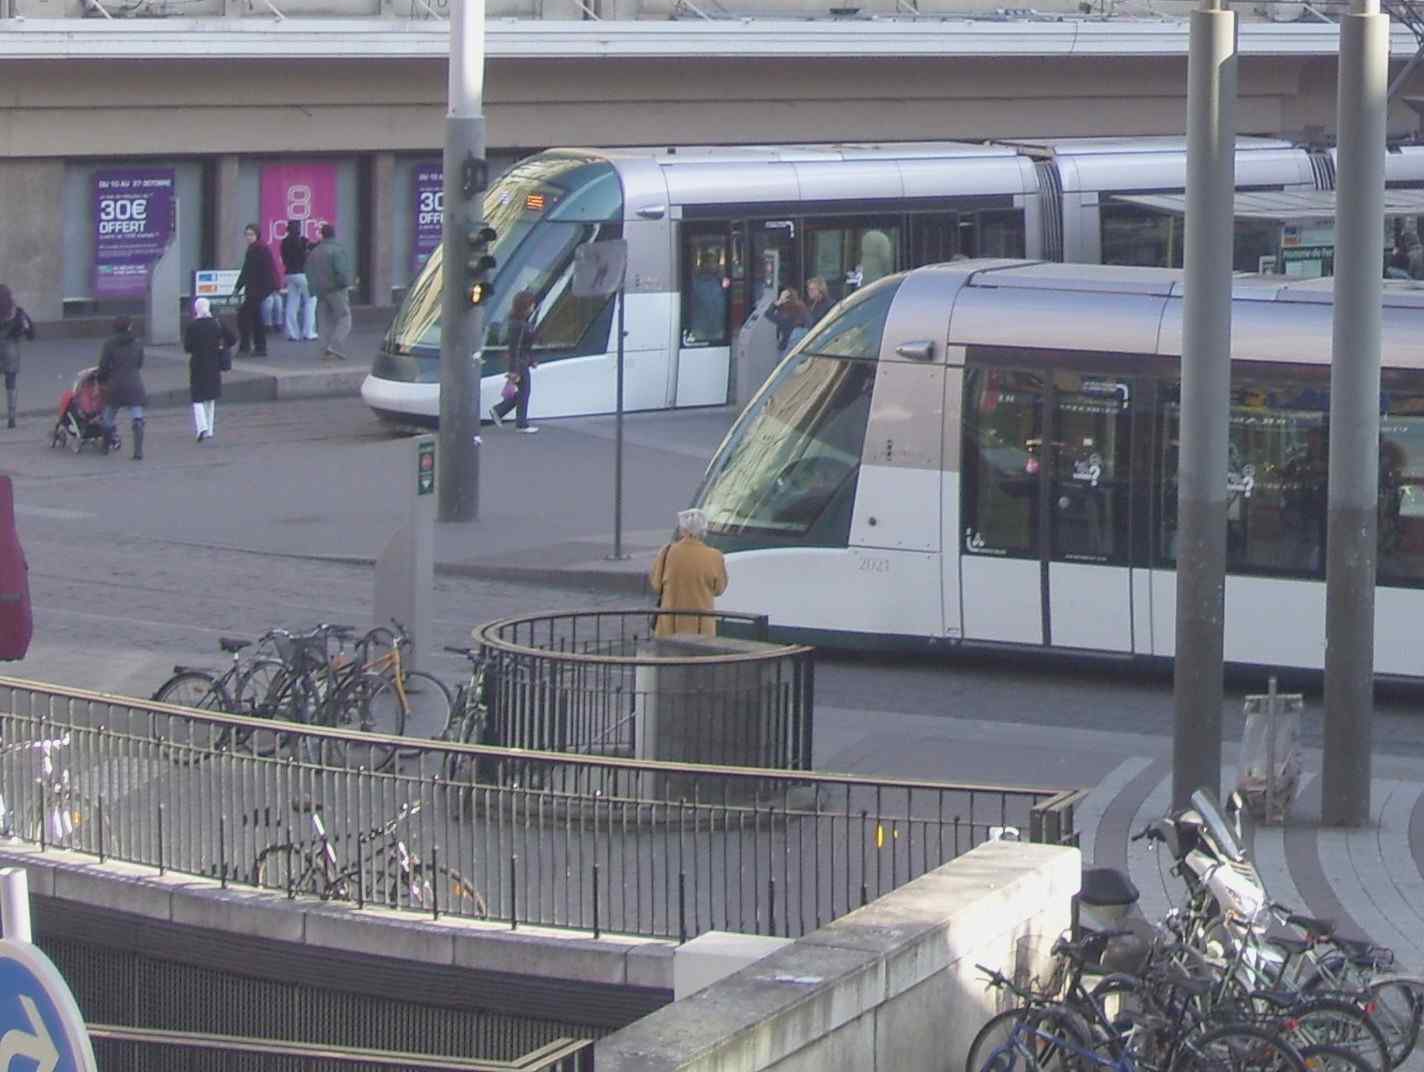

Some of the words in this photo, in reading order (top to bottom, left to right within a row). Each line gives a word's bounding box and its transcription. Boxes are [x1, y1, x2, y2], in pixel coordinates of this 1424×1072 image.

[100, 199, 147, 221] 30€
[287, 184, 312, 220] 8
[99, 220, 147, 234] OFFERT
